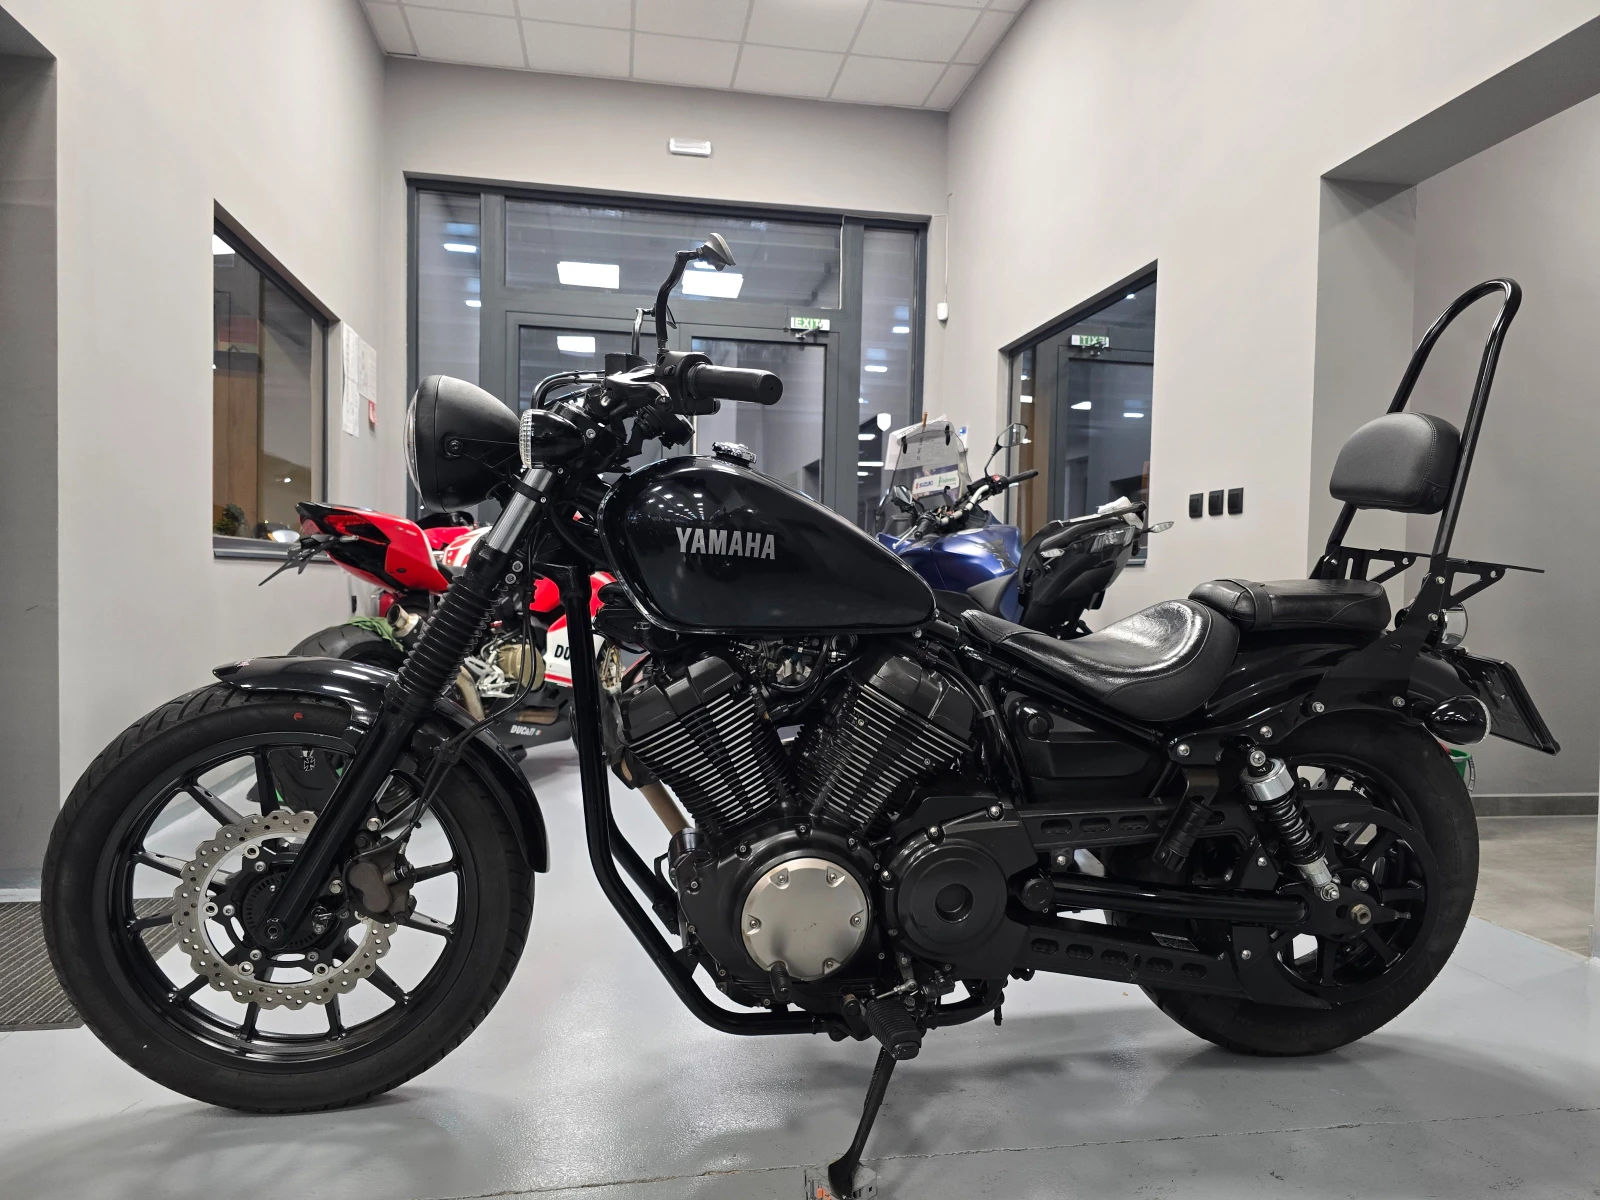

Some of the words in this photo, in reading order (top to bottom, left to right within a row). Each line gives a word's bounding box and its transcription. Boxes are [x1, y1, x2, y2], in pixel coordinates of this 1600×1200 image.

[794, 317, 820, 329] EXIT
[675, 526, 776, 560] YAMAHA
[554, 644, 570, 660] DU
[510, 724, 536, 736] DUCATI
